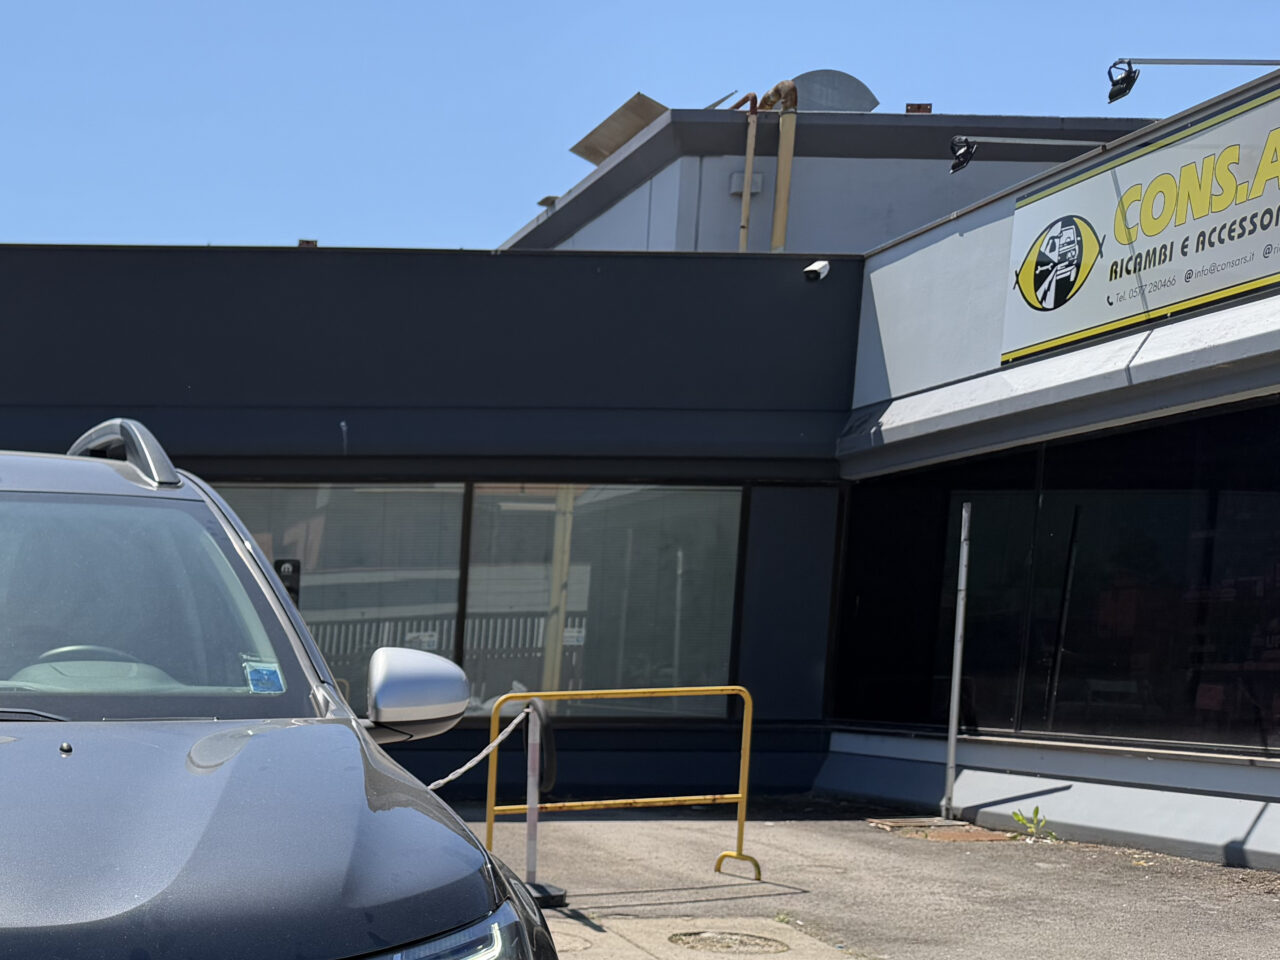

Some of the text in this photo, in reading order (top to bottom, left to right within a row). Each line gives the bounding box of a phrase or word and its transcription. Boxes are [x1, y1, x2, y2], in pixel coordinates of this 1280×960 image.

[1109, 241, 1174, 282] RICAMBI
[1181, 235, 1190, 257] E
[1148, 275, 1176, 294] 280466
